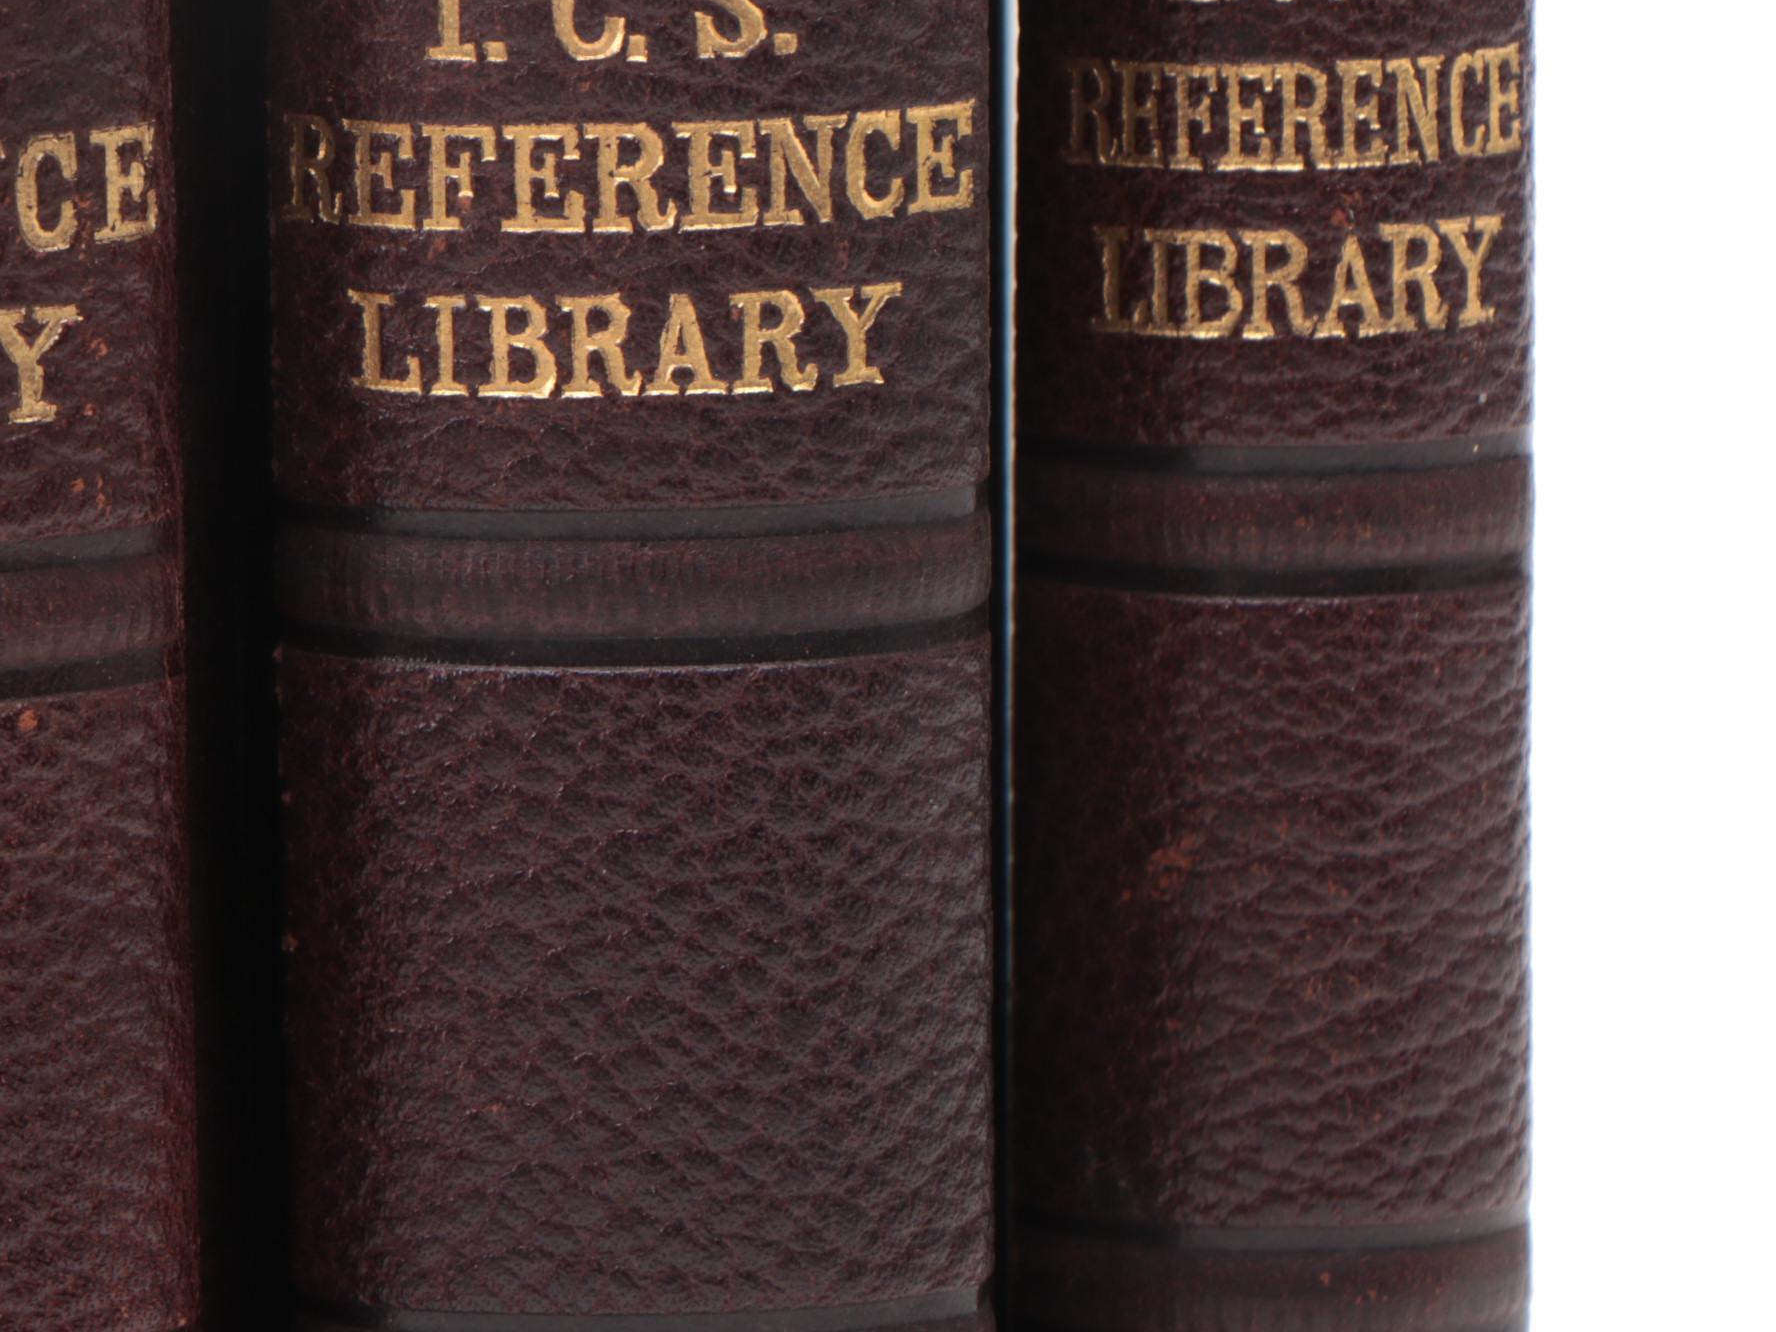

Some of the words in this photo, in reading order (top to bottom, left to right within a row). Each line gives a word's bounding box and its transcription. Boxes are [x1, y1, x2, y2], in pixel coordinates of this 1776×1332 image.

[280, 98, 976, 234] REFERENCE
[1060, 42, 1523, 173] REFERENCE
[347, 282, 904, 400] LIBRARY
[1094, 214, 1504, 340] LIBRARY
